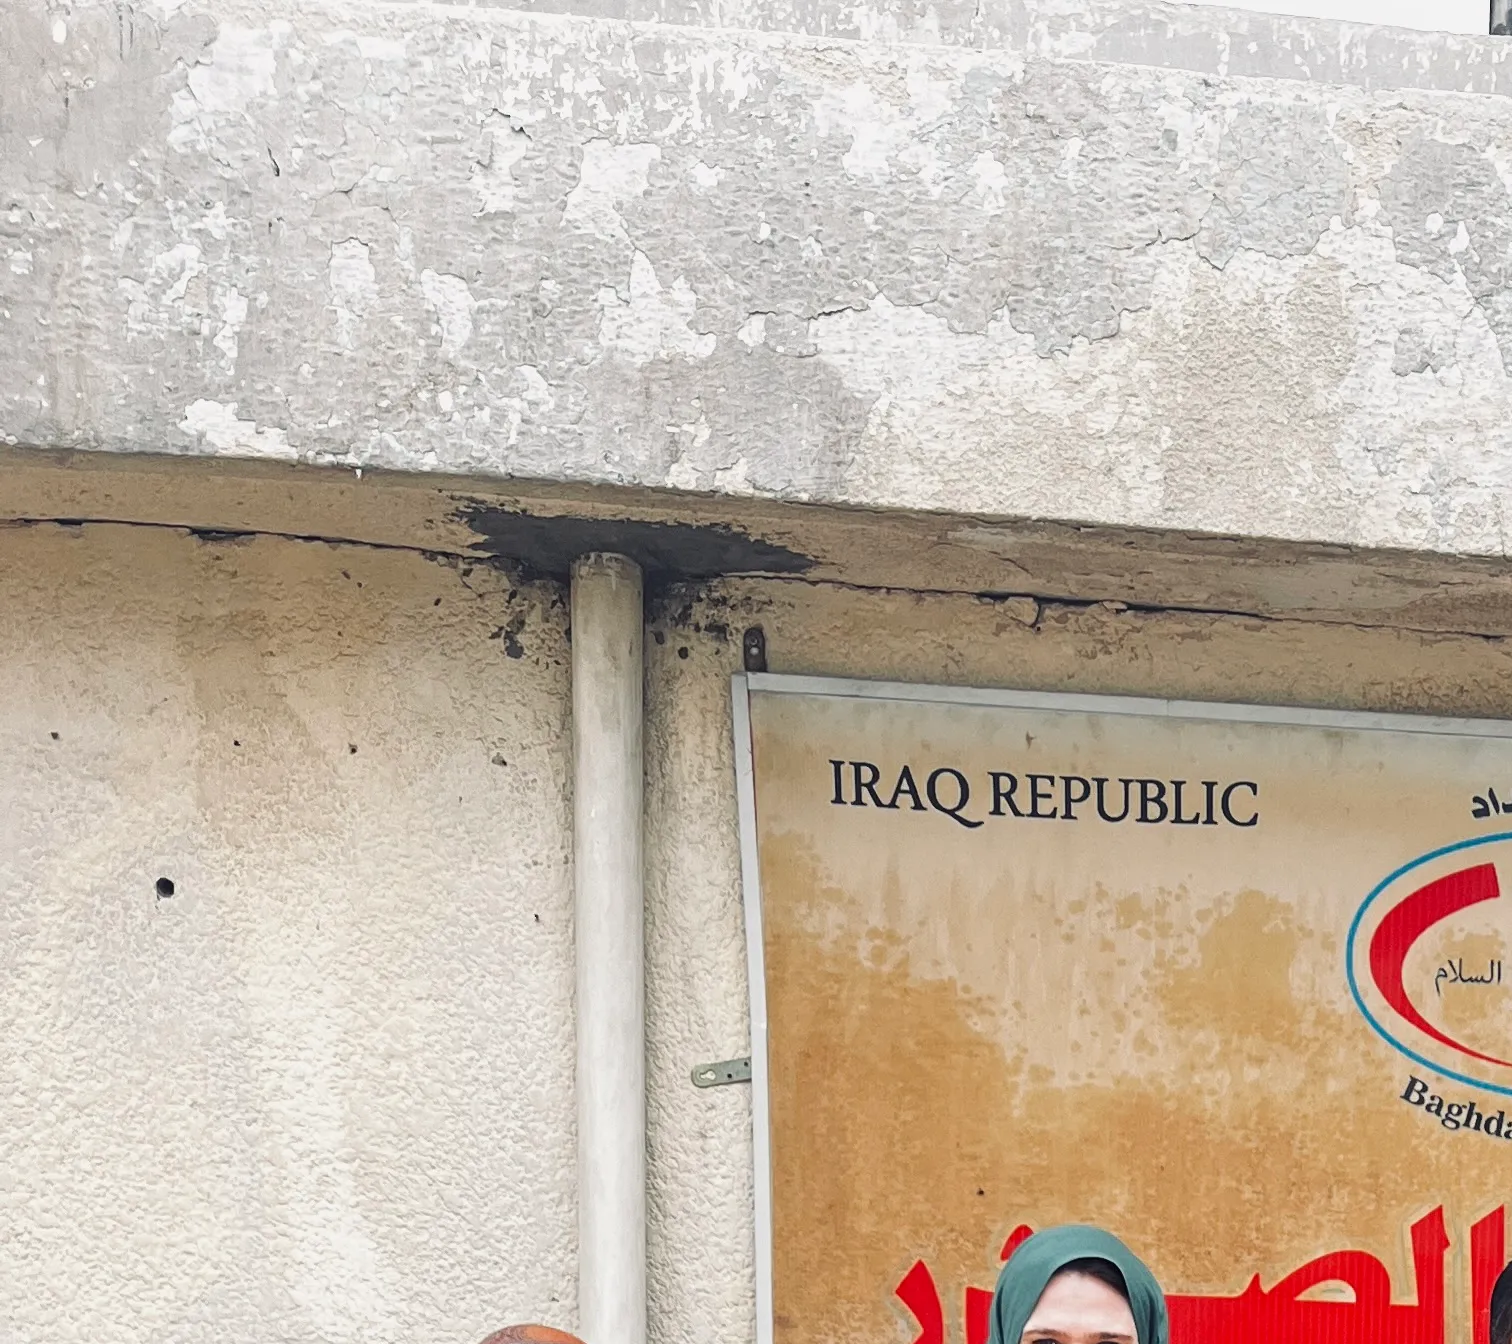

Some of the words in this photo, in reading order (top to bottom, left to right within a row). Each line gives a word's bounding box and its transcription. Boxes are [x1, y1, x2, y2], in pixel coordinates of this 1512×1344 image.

[828, 757, 985, 827] IRAQ
[988, 770, 1261, 827] REPUBLIC
[1433, 958, 1502, 997] السلام
